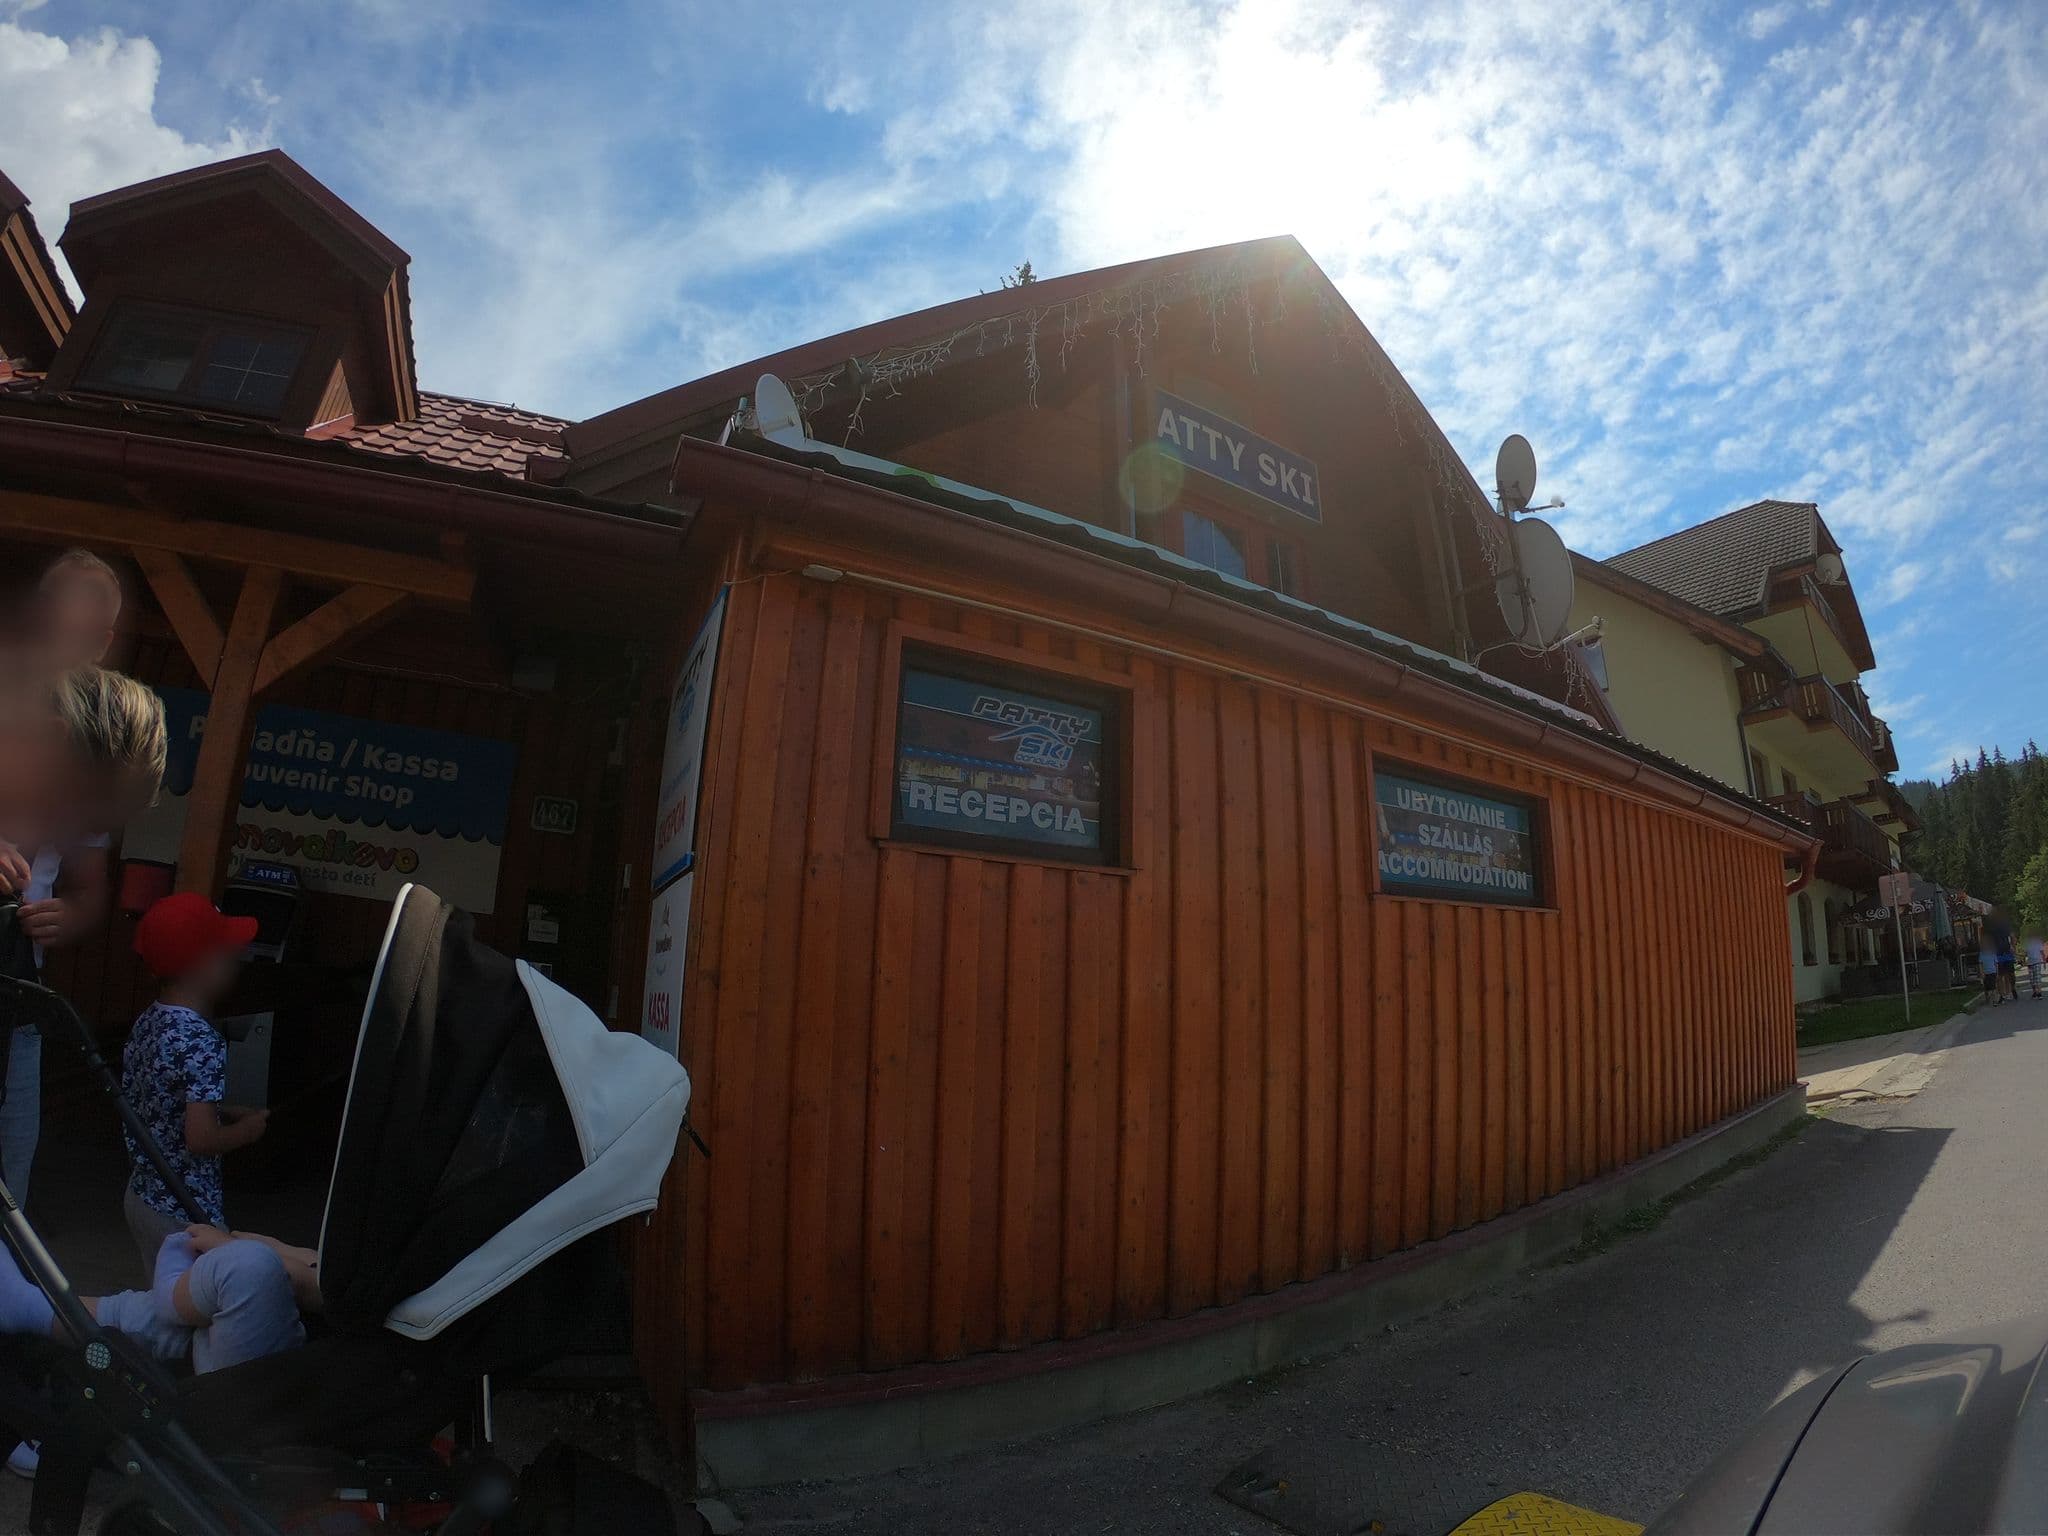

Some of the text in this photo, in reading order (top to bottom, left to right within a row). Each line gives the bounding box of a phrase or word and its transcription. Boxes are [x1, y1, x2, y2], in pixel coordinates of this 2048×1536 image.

[1157, 407, 1315, 506] ATTY SKI
[972, 695, 1092, 746] PATTY
[188, 714, 336, 763] Padňa
[362, 743, 460, 782] Kassa
[1017, 736, 1074, 762] SKI
[245, 762, 415, 809] uvenir Shop
[908, 780, 1087, 835] RECEPCIA
[1396, 787, 1506, 829] UBYTOVANIE
[1417, 823, 1494, 857] SZÁLLÁS
[255, 869, 281, 880] ATM
[1378, 850, 1529, 891] ACCOMMODATION
[648, 991, 671, 1033] KASSA
